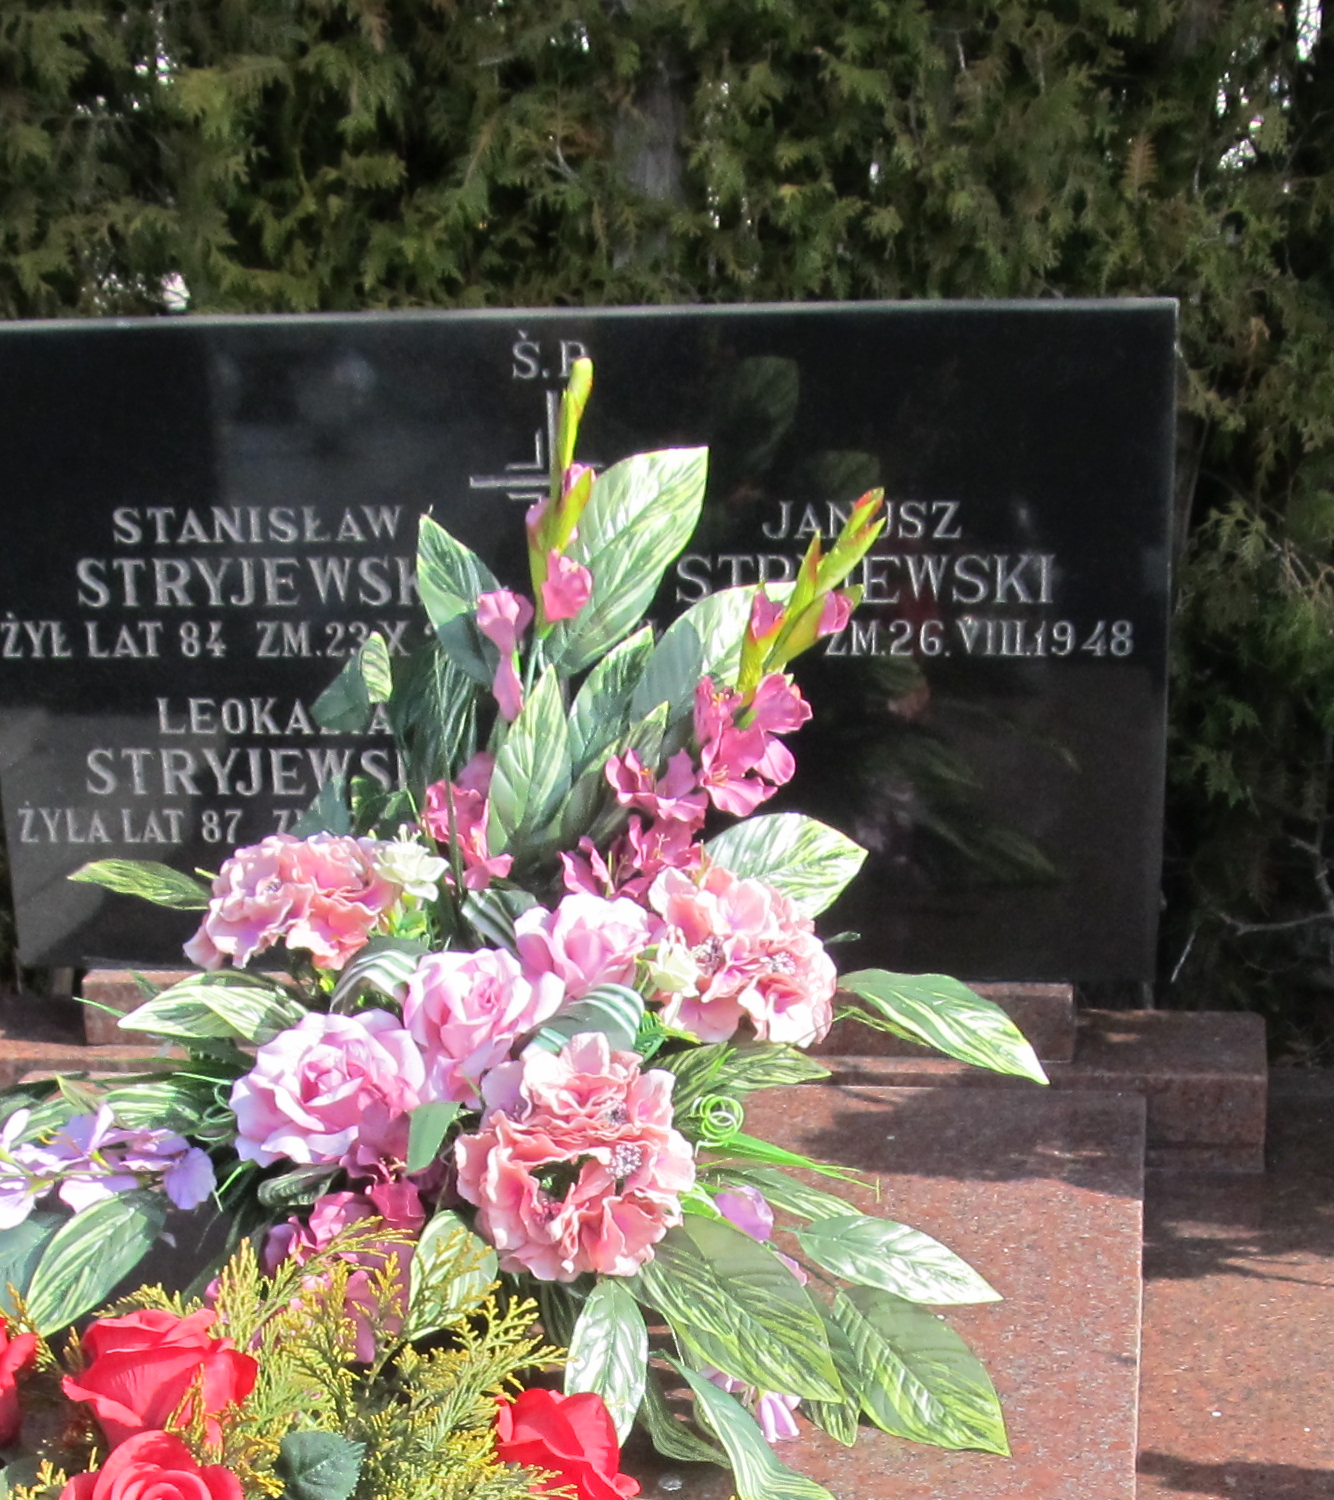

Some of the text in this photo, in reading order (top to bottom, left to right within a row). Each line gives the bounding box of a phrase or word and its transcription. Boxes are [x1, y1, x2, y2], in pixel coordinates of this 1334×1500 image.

[111, 505, 402, 546] STANISŁAW
[76, 555, 424, 609] STRYJEWSK
[675, 553, 1057, 604] STREWSKI
[0, 612, 71, 659] ŻYŁ
[87, 621, 164, 659] LAT
[180, 621, 226, 658] 84
[157, 697, 396, 737] LEOKAA
[86, 746, 408, 798] STRYJEWS
[18, 807, 112, 845] ŻYŁA
[121, 808, 184, 844] LAT
[202, 808, 243, 844] 87
